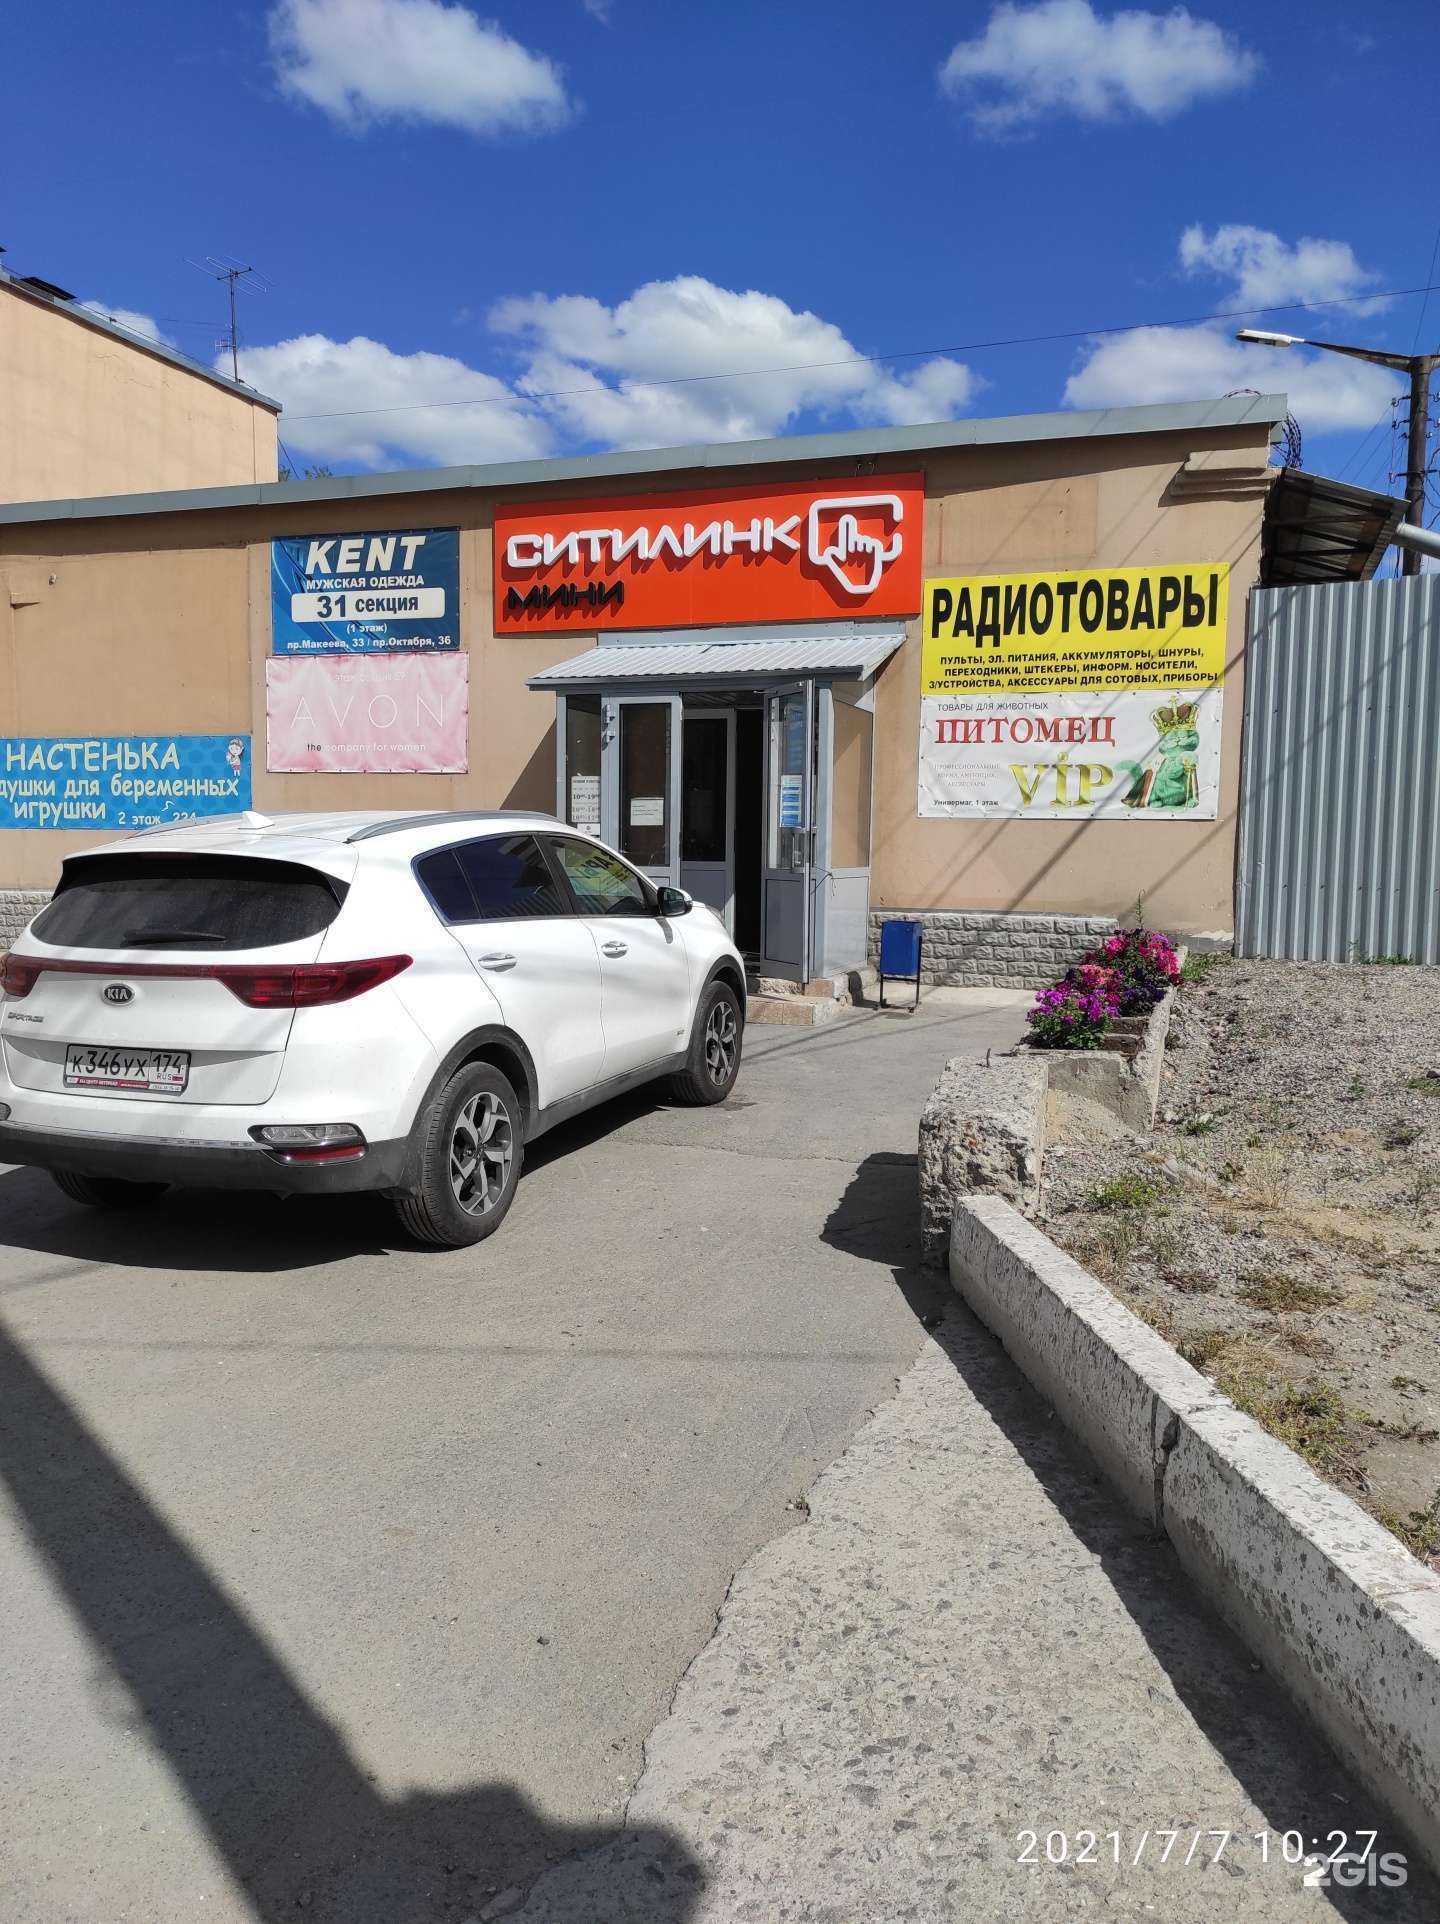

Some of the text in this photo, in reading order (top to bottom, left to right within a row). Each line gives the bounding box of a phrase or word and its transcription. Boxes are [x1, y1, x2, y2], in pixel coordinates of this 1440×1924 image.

[507, 515, 801, 568] СИТИЛИНК
[305, 536, 426, 574] KENT
[306, 575, 424, 590] МУЖСКАЯ ОДЕЖДА
[507, 580, 625, 610] МИНИ
[316, 595, 418, 618] 31 секция
[931, 574, 1219, 648] РАДИОТОВАРЫ
[352, 638, 365, 647] 33
[438, 636, 451, 645] 36
[945, 666, 1021, 677] ПЕРЕХОДНИКИ,
[1007, 676, 1077, 687] АКСЕССУАРЫ
[1080, 675, 1102, 686] ДЛЯ
[1163, 672, 1218, 683] ПРИБОРЫ
[290, 693, 448, 729] AVON
[937, 702, 1048, 712] ТОВАРЫ ДЛЯ ЖИВОТНЫХ
[934, 715, 1117, 747] ПИТОМЕЦ
[6, 741, 181, 771] НАСТЕНЬКА
[307, 743, 321, 752] the
[64, 778, 100, 799] для
[110, 772, 239, 803] беременных
[14, 801, 106, 826] игрушки
[118, 811, 126, 825] 2
[131, 814, 161, 825] этаж
[107, 988, 129, 1000] KIA
[152, 1053, 181, 1074] 174
[156, 1072, 173, 1081] RUS
